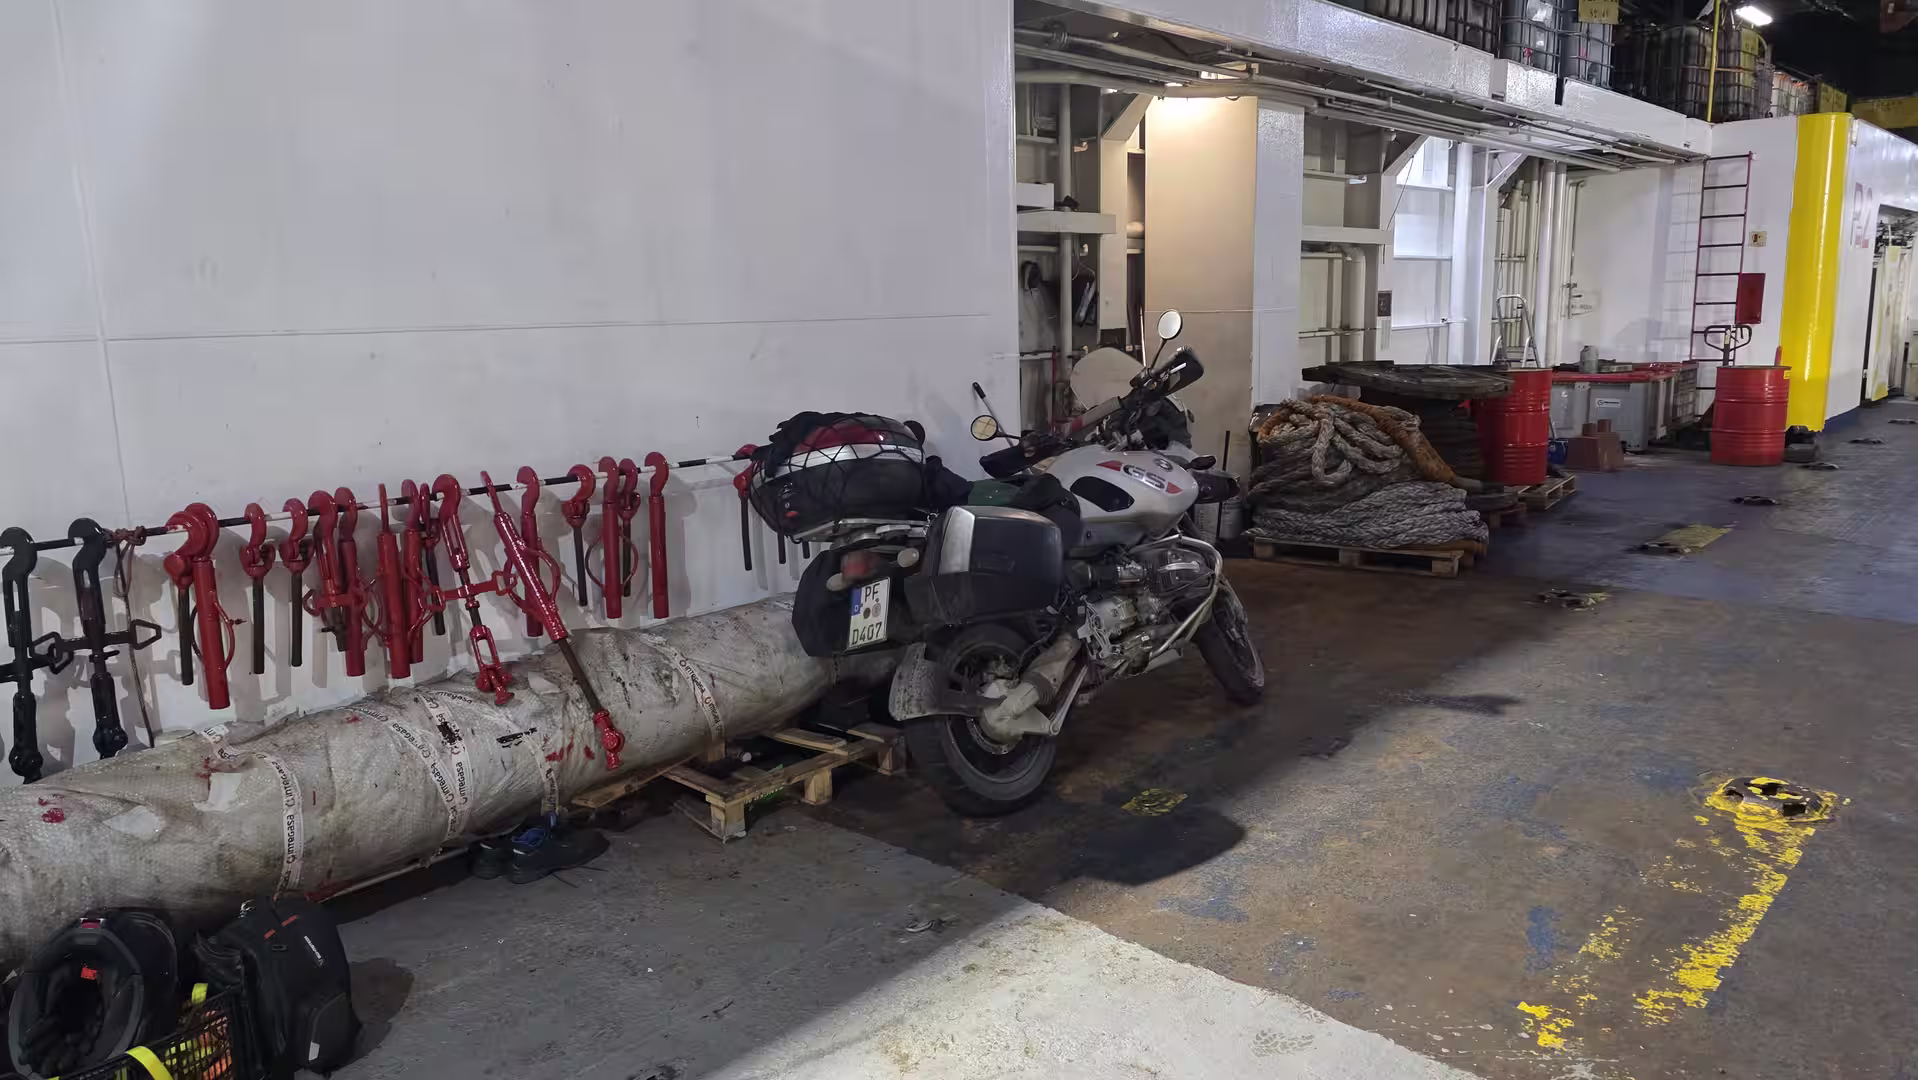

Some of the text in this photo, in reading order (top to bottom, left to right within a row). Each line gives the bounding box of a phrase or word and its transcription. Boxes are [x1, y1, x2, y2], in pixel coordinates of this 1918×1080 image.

[1123, 464, 1165, 488] GS
[865, 583, 880, 602] PF
[851, 622, 882, 645] D407
